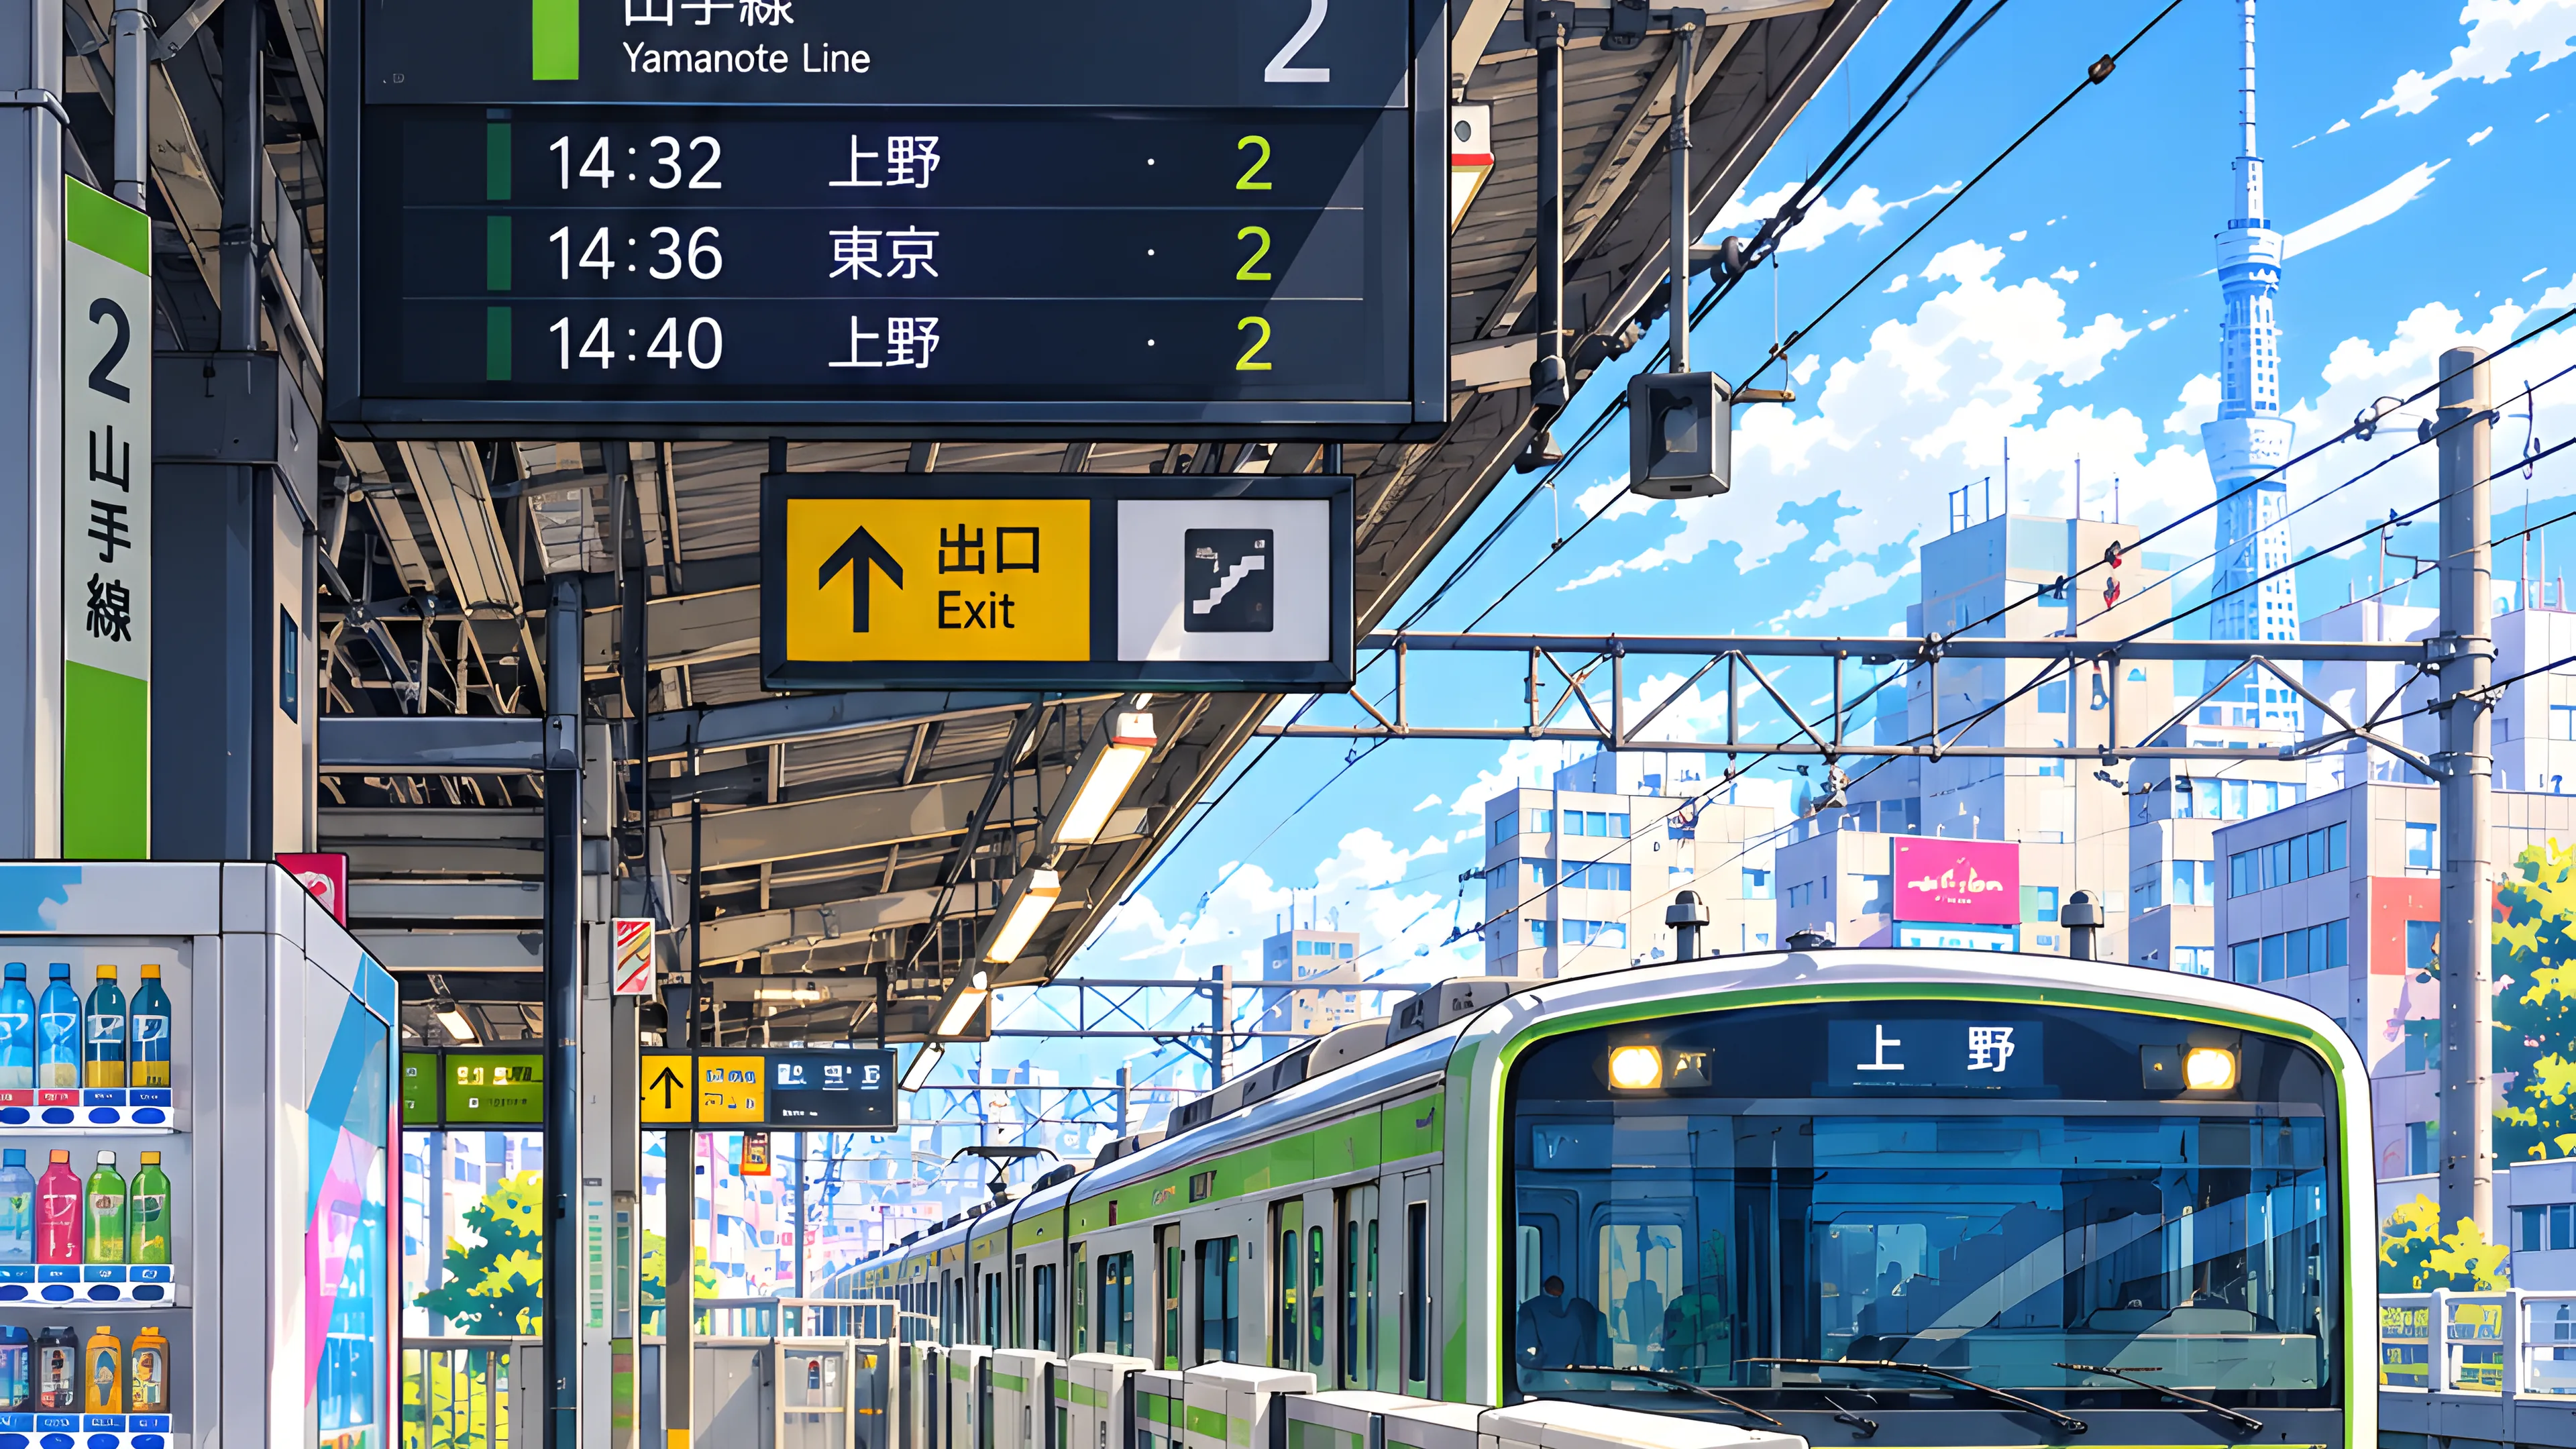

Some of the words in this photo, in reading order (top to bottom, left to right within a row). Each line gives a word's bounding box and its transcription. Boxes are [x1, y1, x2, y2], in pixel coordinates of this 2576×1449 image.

[623, 41, 788, 73] Yamanote
[803, 42, 871, 73] Line
[1264, 0, 1330, 83] 2
[549, 136, 722, 189] 14:32
[828, 135, 941, 189] 上野
[1236, 136, 1273, 190] 2
[549, 225, 722, 279] 14:36
[828, 225, 941, 279] 東京
[1236, 225, 1273, 280] 2
[88, 297, 131, 404] 2
[549, 316, 722, 370] 14:40
[828, 315, 941, 370] 上野
[1236, 316, 1273, 370] 2
[86, 425, 132, 643] 山手線
[938, 523, 1040, 575] 出口
[938, 590, 1015, 629] Exit
